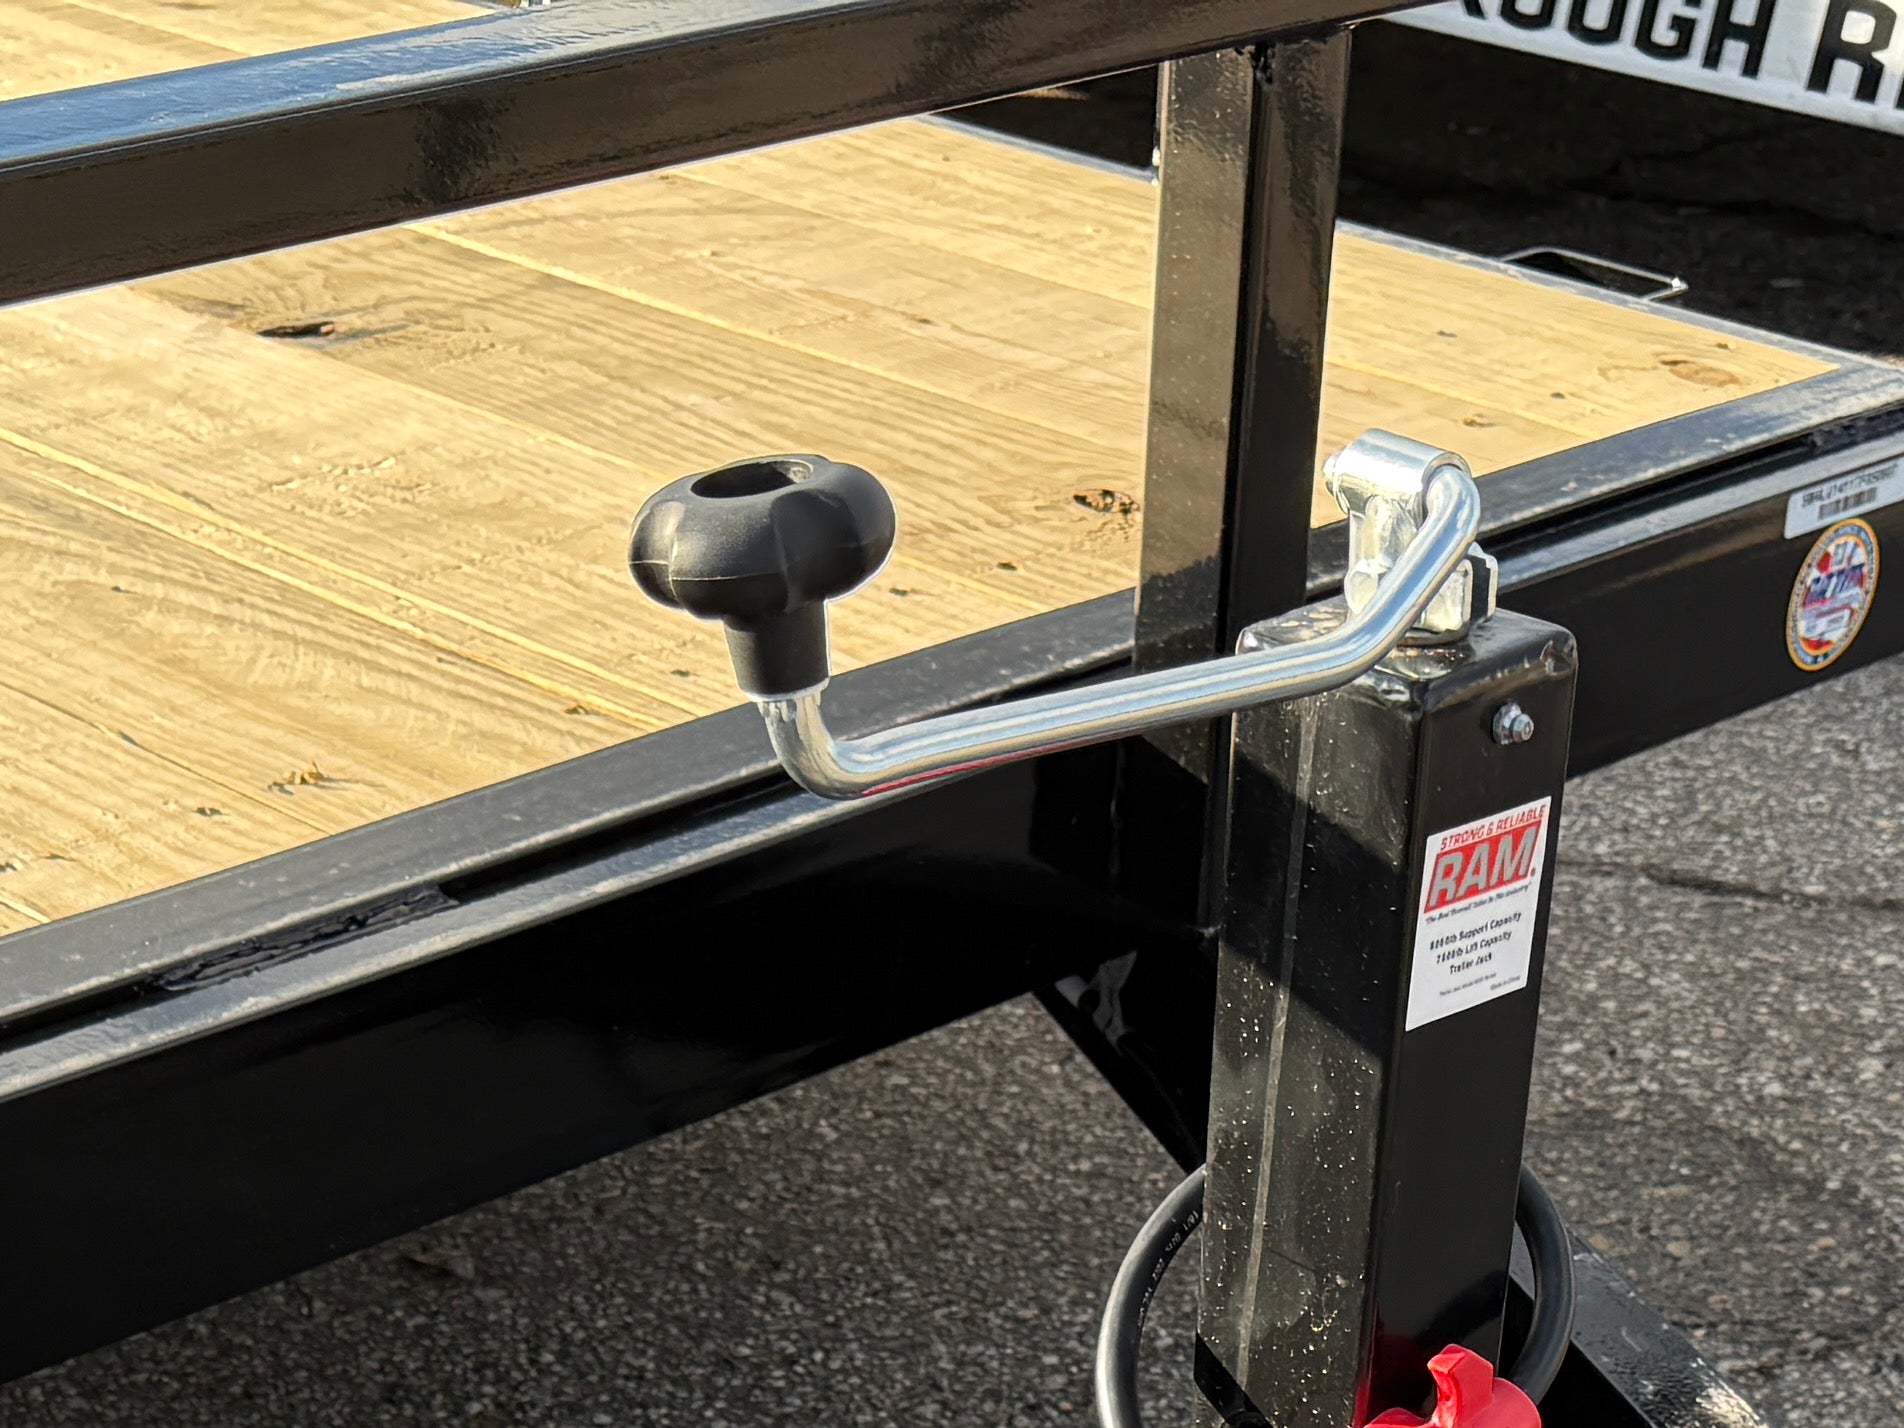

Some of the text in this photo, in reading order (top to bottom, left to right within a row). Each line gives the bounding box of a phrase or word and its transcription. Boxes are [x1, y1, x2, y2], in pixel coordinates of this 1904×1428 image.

[1441, 823, 1485, 851] STRONG
[1495, 804, 1546, 834] RELIABLE
[1429, 826, 1537, 907] RAM
[1458, 921, 1487, 942] Support
[1489, 909, 1522, 931] Capacity
[1479, 928, 1511, 950] Capacity
[1449, 950, 1492, 975] Trailer Jack
